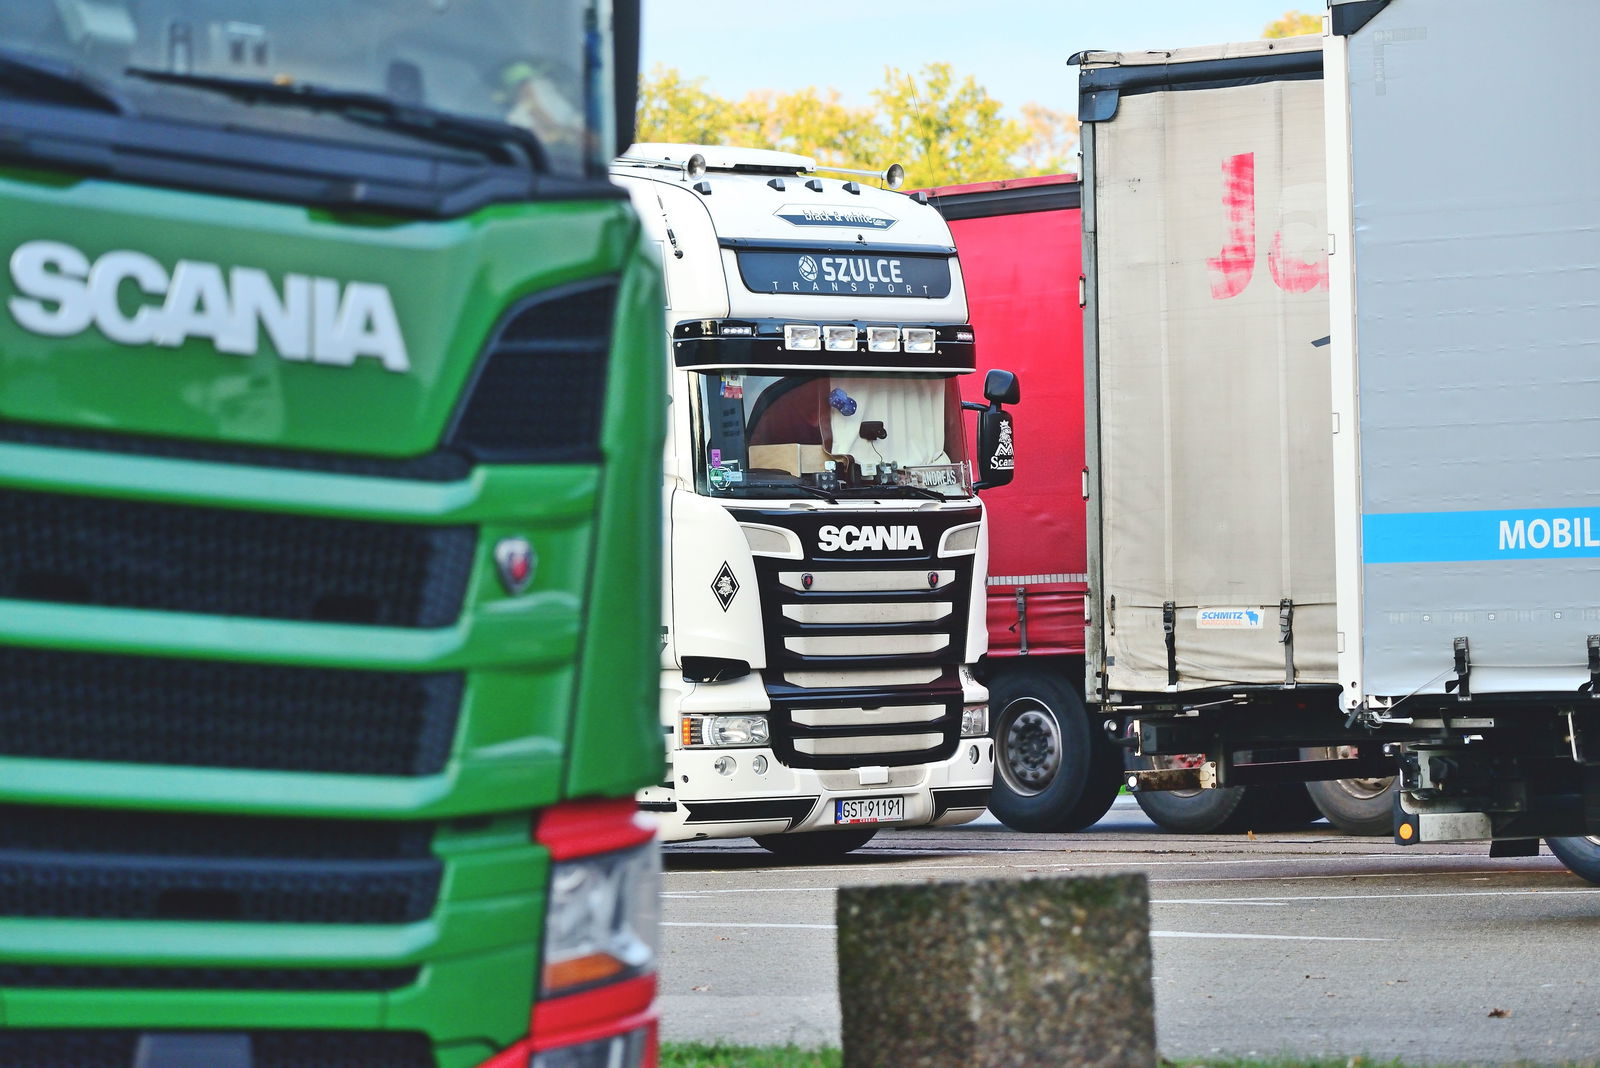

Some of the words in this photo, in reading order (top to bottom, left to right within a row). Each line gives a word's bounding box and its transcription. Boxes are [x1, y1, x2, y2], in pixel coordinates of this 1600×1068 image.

[802, 210, 833, 222] black
[834, 211, 843, 222] &
[844, 211, 874, 224] white
[821, 257, 904, 284] SZULCE
[772, 281, 929, 295] TRANSPORT
[8, 240, 411, 373] SCANIA
[817, 525, 924, 552] SCANIA
[1498, 516, 1600, 551] MOBIL
[1201, 611, 1244, 620] SCHMITZ
[842, 800, 865, 818] GST
[867, 798, 900, 817] 91191
